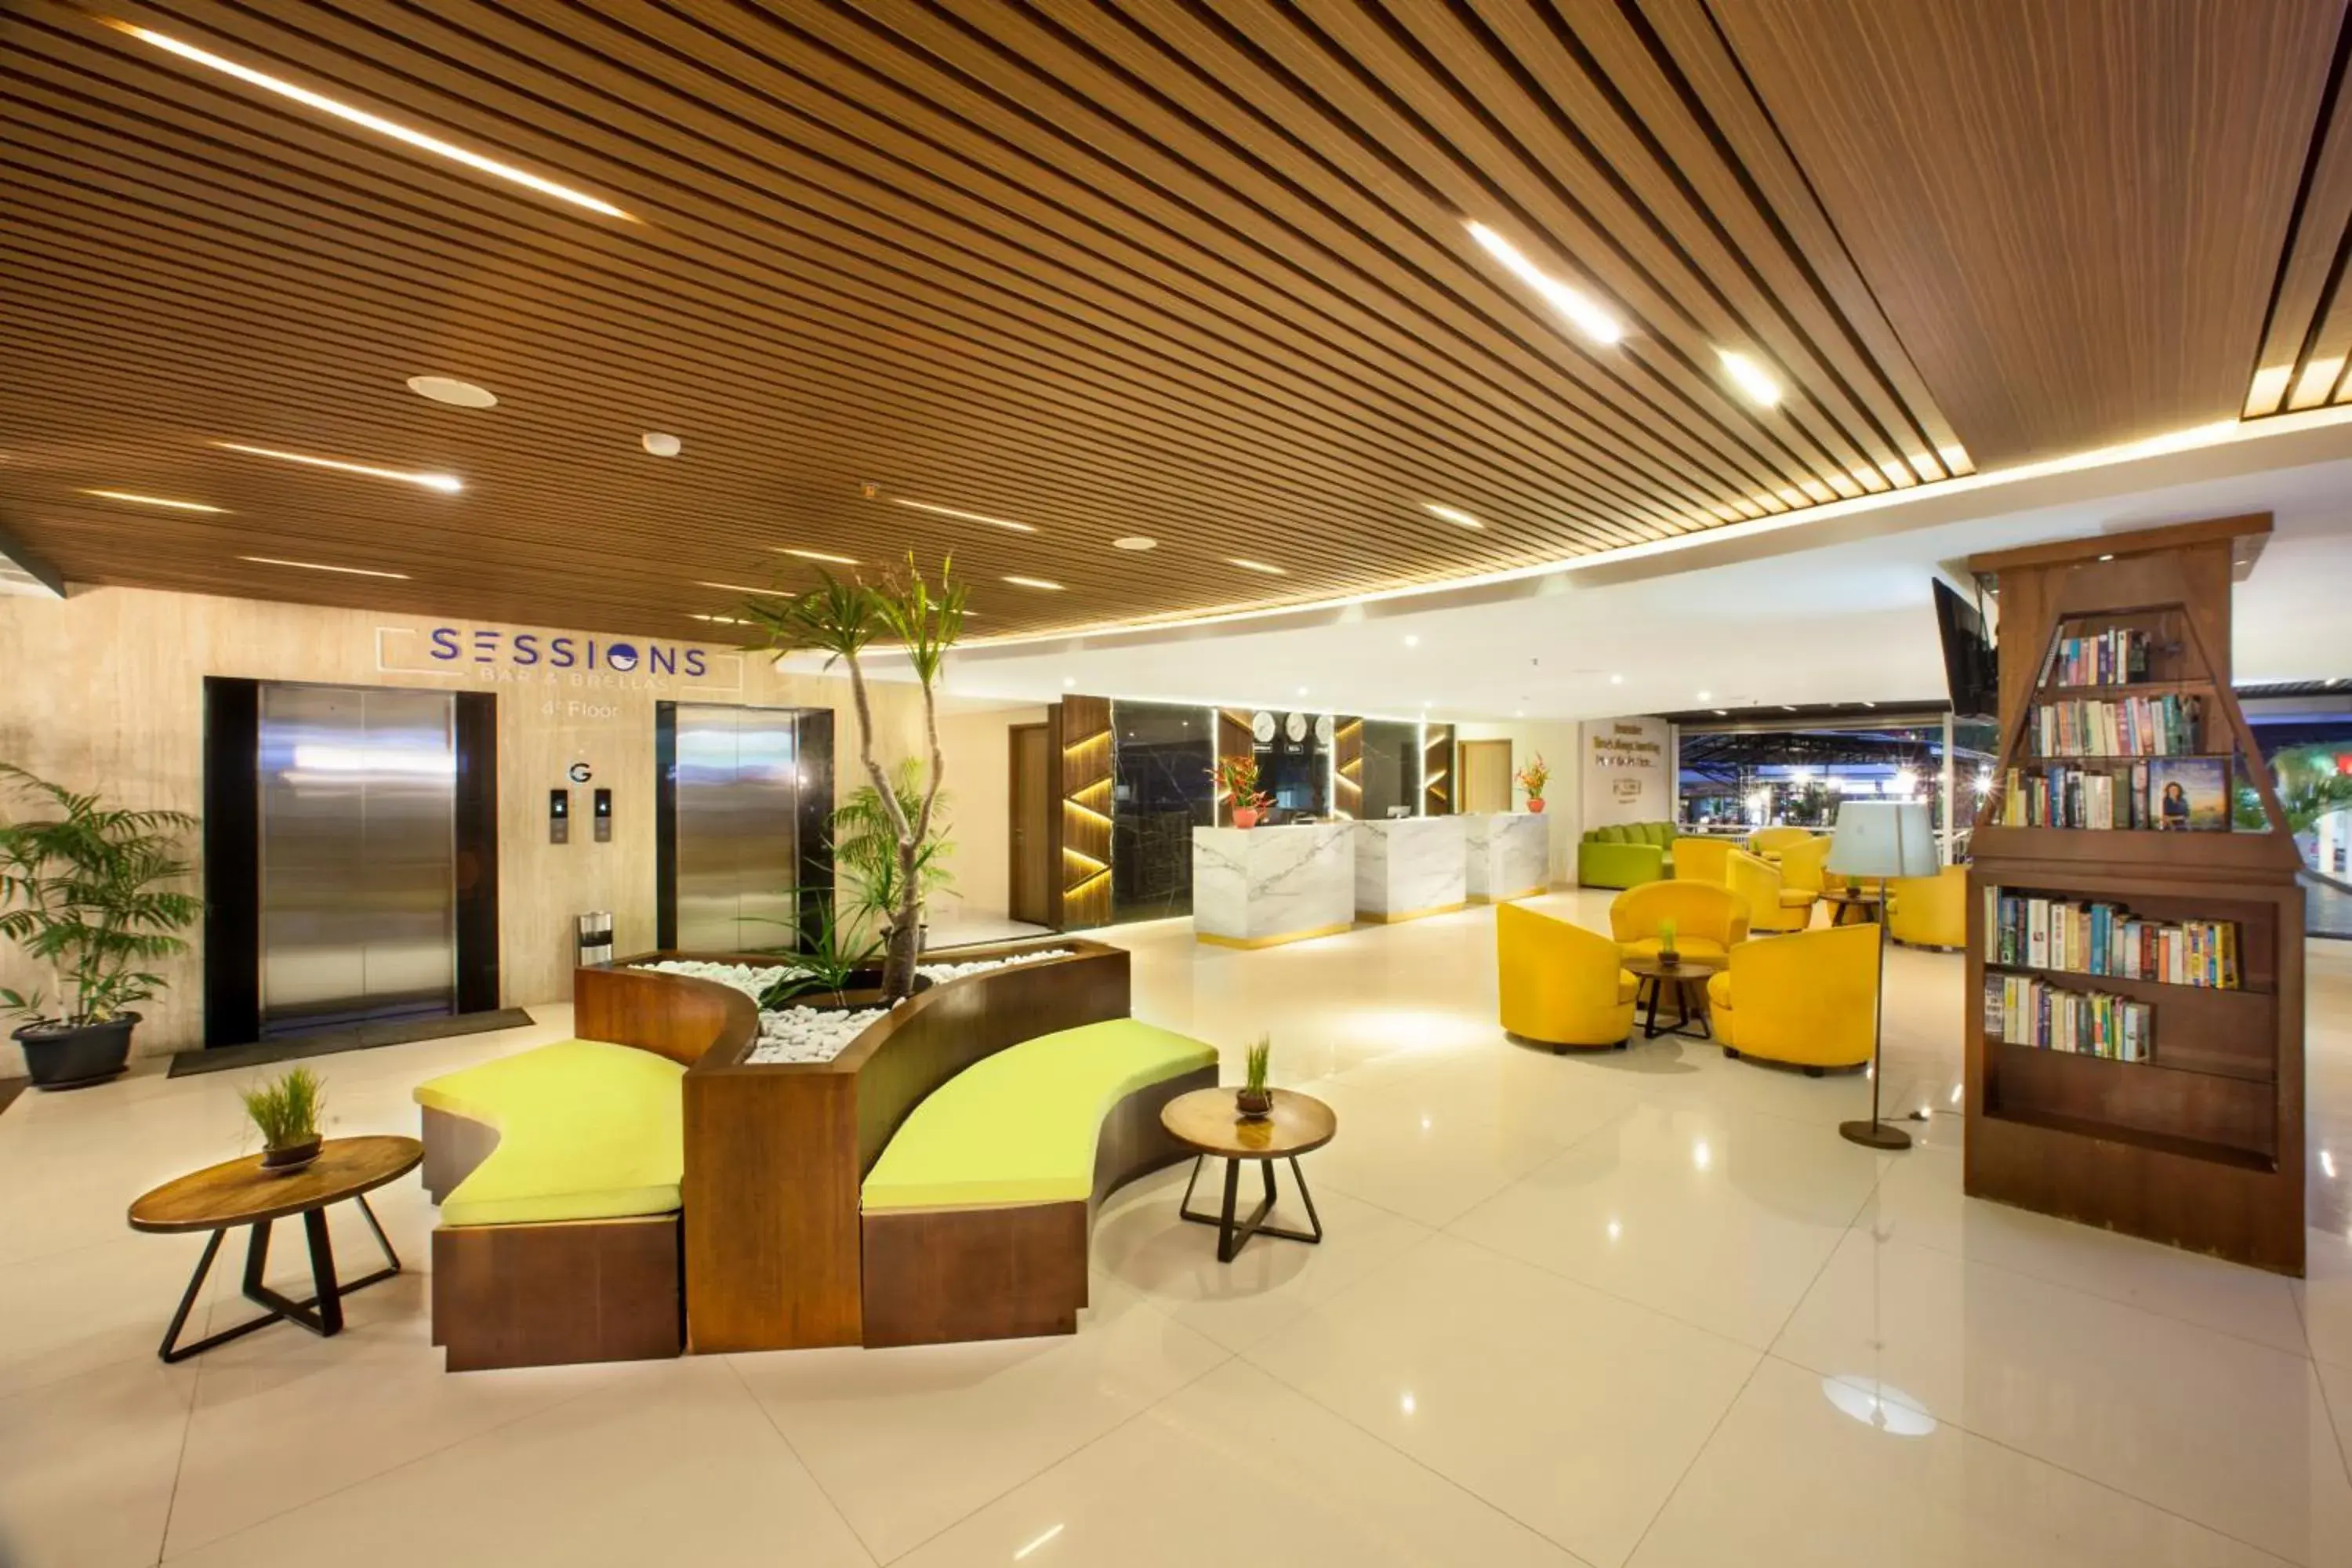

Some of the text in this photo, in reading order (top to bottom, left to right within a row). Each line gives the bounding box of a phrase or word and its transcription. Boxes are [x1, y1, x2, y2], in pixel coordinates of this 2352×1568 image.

[430, 627, 706, 677] SESSIONS
[480, 667, 532, 684] BAR
[571, 672, 668, 691] BRELLAS
[568, 700, 619, 718] Floor
[569, 763, 593, 783] G
